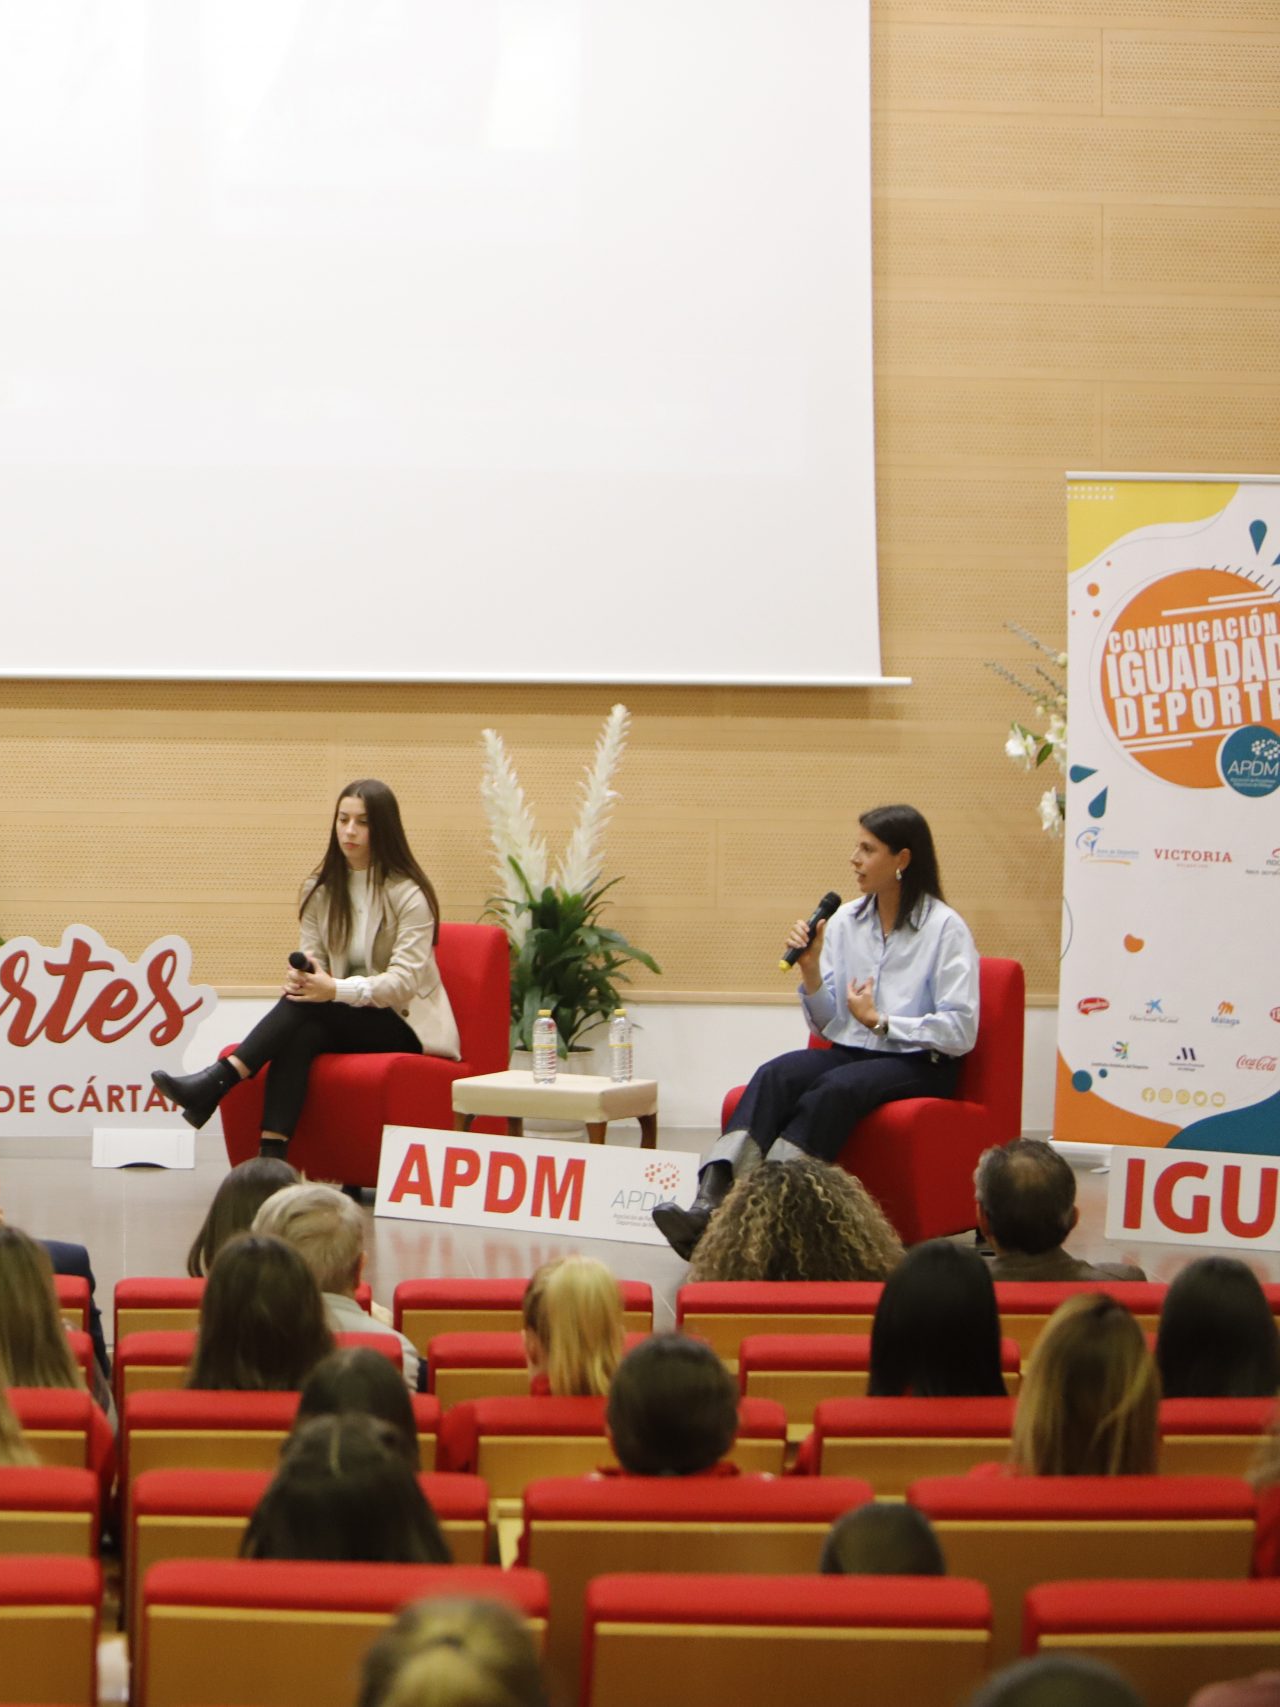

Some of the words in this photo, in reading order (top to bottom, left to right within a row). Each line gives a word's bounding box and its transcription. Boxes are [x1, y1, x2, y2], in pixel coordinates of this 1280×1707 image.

[1108, 608, 1277, 654] COMUNICACIÓN
[1227, 759, 1280, 777] APDM
[1153, 848, 1234, 864] VICTORIA
[47, 1076, 177, 1114] CÁRTA
[387, 1143, 587, 1222] APDM
